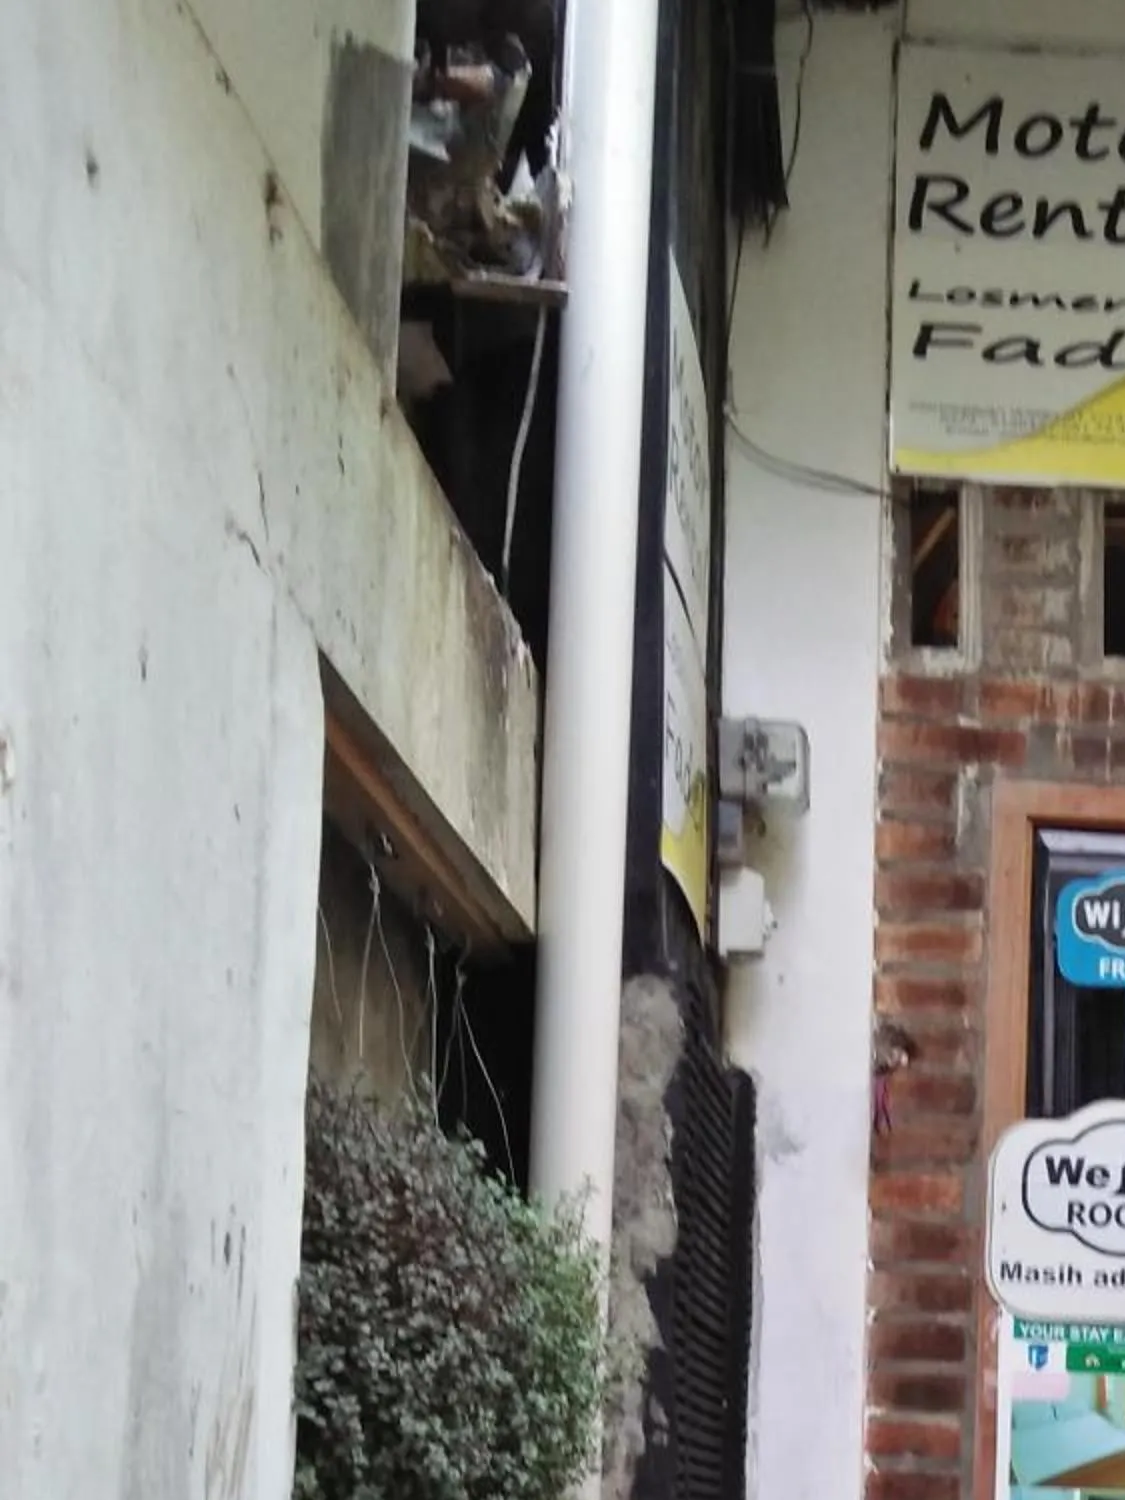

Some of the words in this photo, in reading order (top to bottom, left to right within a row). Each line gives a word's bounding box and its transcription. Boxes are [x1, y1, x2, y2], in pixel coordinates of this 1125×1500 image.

[1045, 1155, 1111, 1189] We
[999, 1260, 1083, 1288] Masih
[1019, 1322, 1064, 1340] YOUR
[1069, 1326, 1108, 1342] STAY
